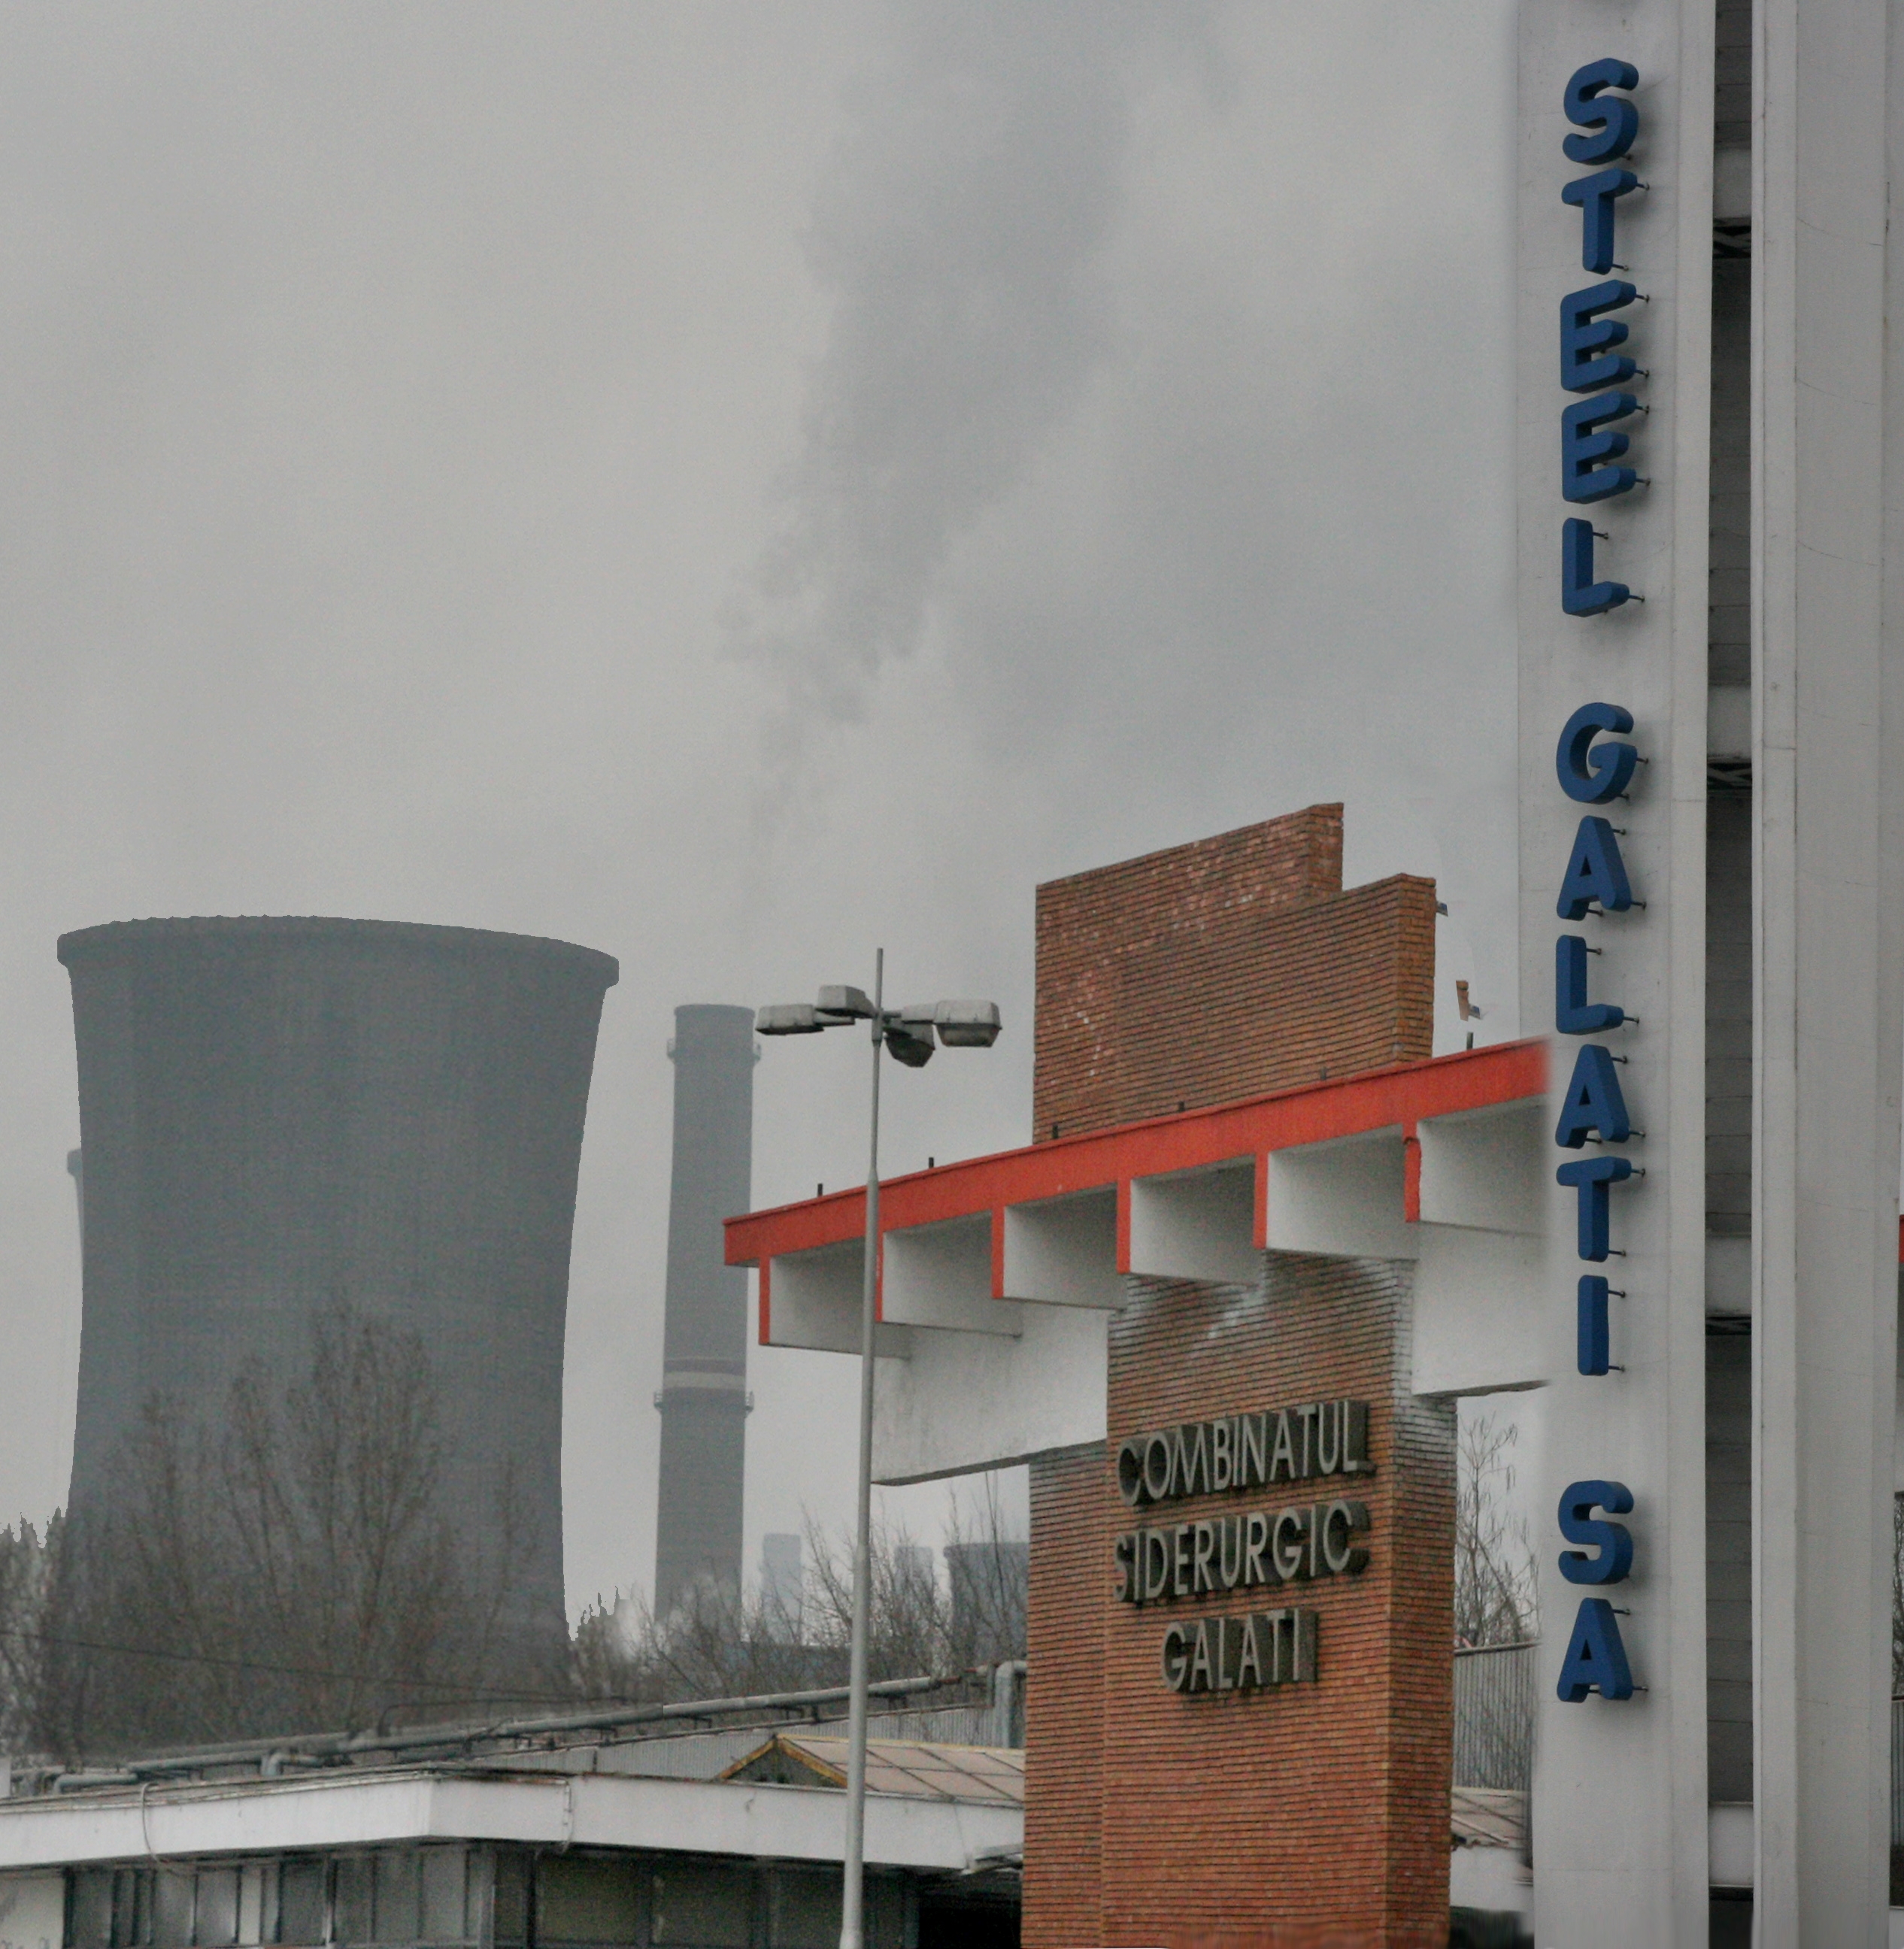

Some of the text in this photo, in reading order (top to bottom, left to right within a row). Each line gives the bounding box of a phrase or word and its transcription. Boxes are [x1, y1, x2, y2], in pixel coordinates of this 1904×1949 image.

[1555, 57, 1640, 1704] STEEL GALATI SA
[1117, 1399, 1374, 1505] COMBINATUL
[1114, 1500, 1369, 1603] SIDERURGIC
[1161, 1608, 1319, 1693] GALATI
